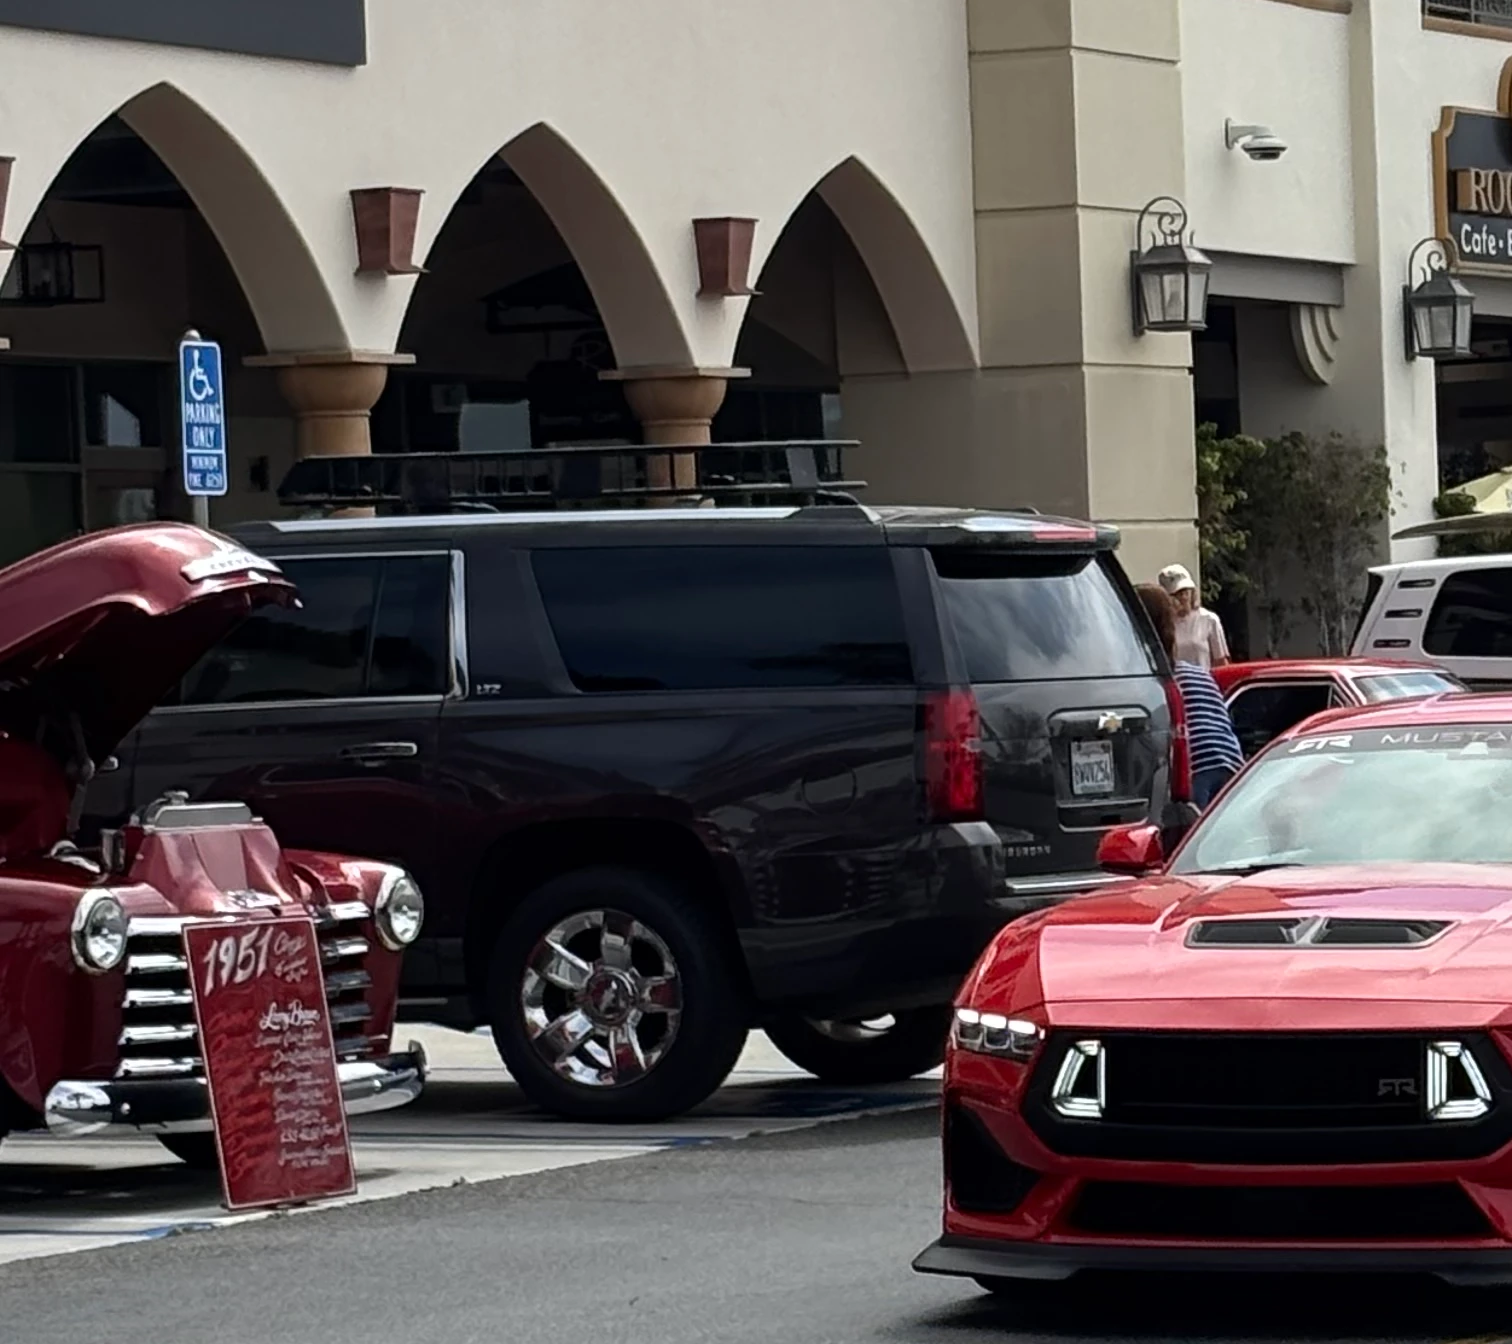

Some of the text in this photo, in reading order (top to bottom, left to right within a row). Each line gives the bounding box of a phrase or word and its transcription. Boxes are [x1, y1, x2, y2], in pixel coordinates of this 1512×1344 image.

[1461, 223, 1497, 256] Cafe
[185, 402, 221, 424] PARKING
[192, 425, 216, 448] ONLY
[203, 926, 274, 997] 1951
